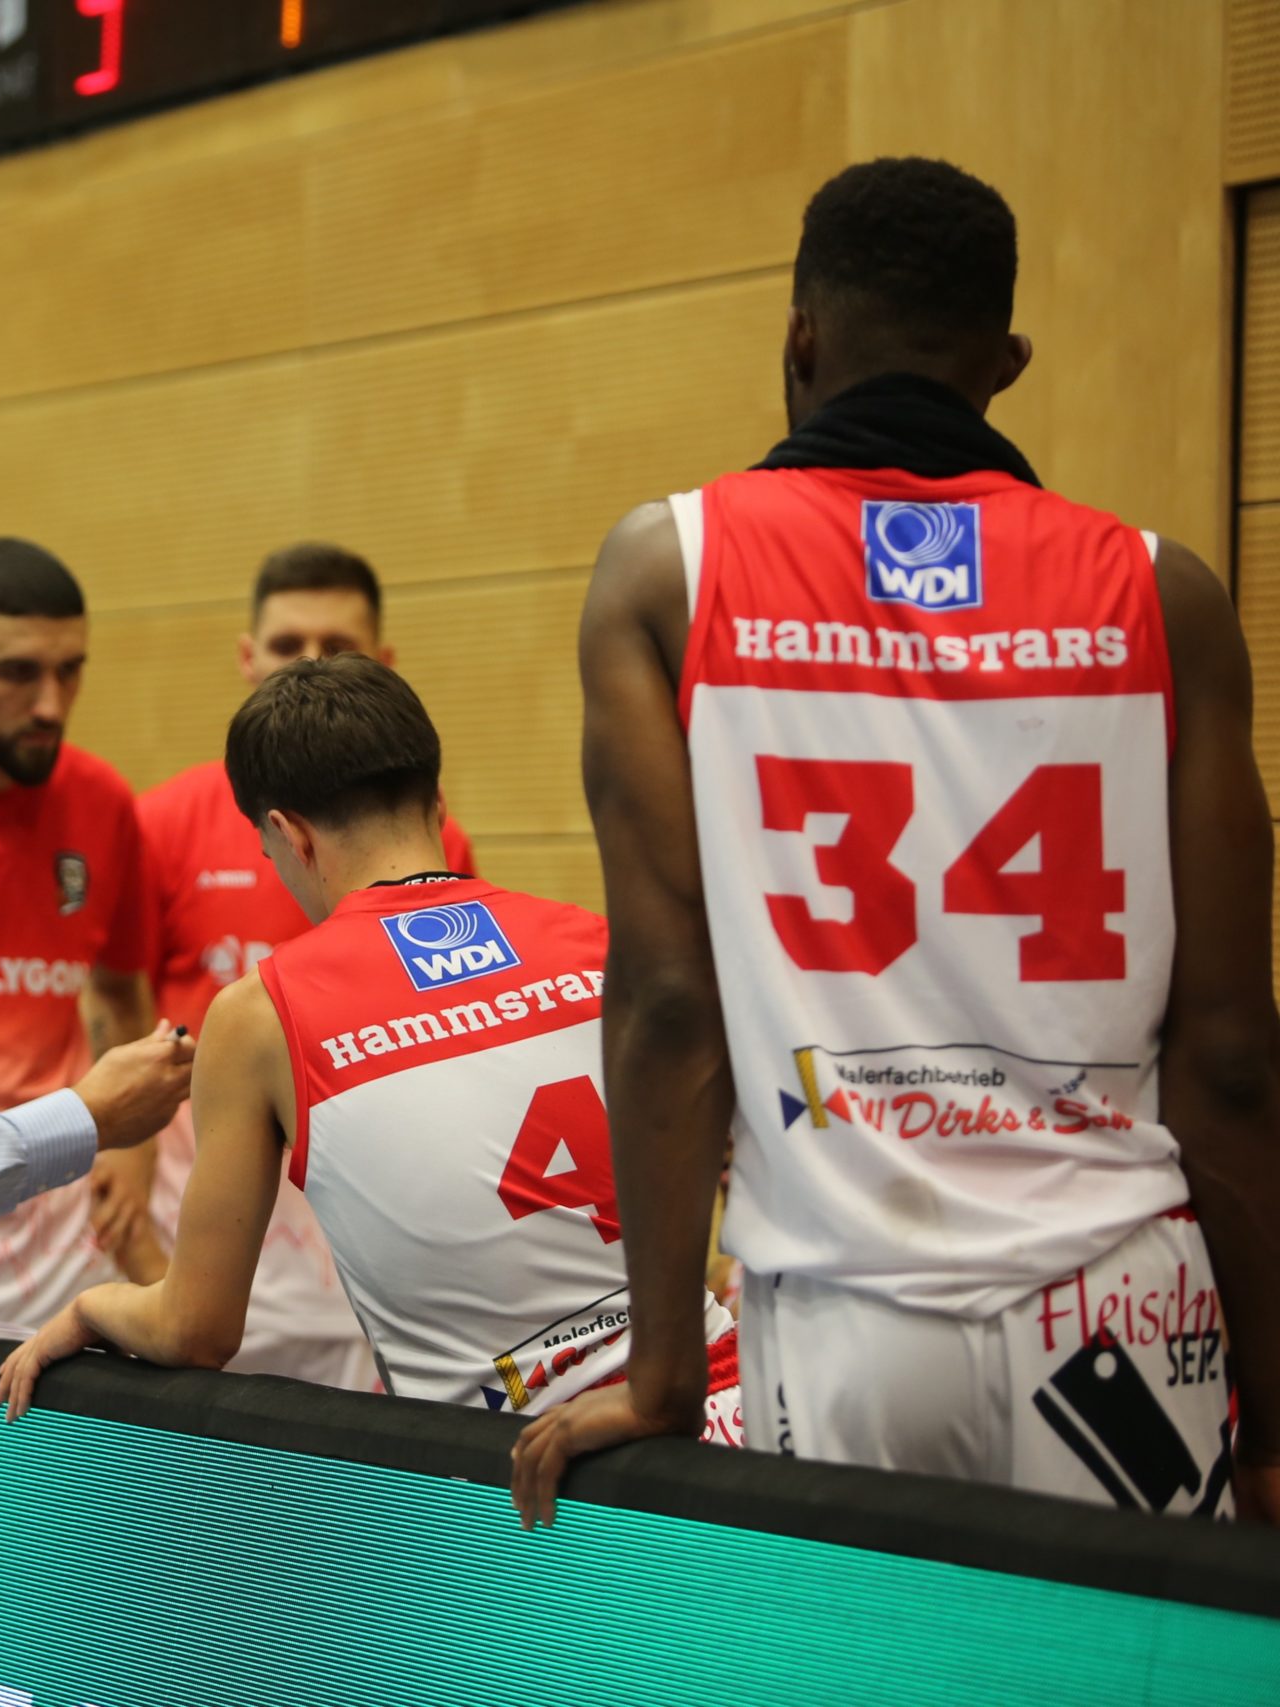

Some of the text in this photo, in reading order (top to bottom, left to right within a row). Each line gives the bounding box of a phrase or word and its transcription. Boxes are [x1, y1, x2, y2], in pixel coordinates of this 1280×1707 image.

[877, 560, 969, 603] WDI
[754, 753, 1127, 984] 34
[411, 940, 507, 981] WDI
[892, 1091, 1022, 1140] Dirks
[1027, 1105, 1047, 1131] &
